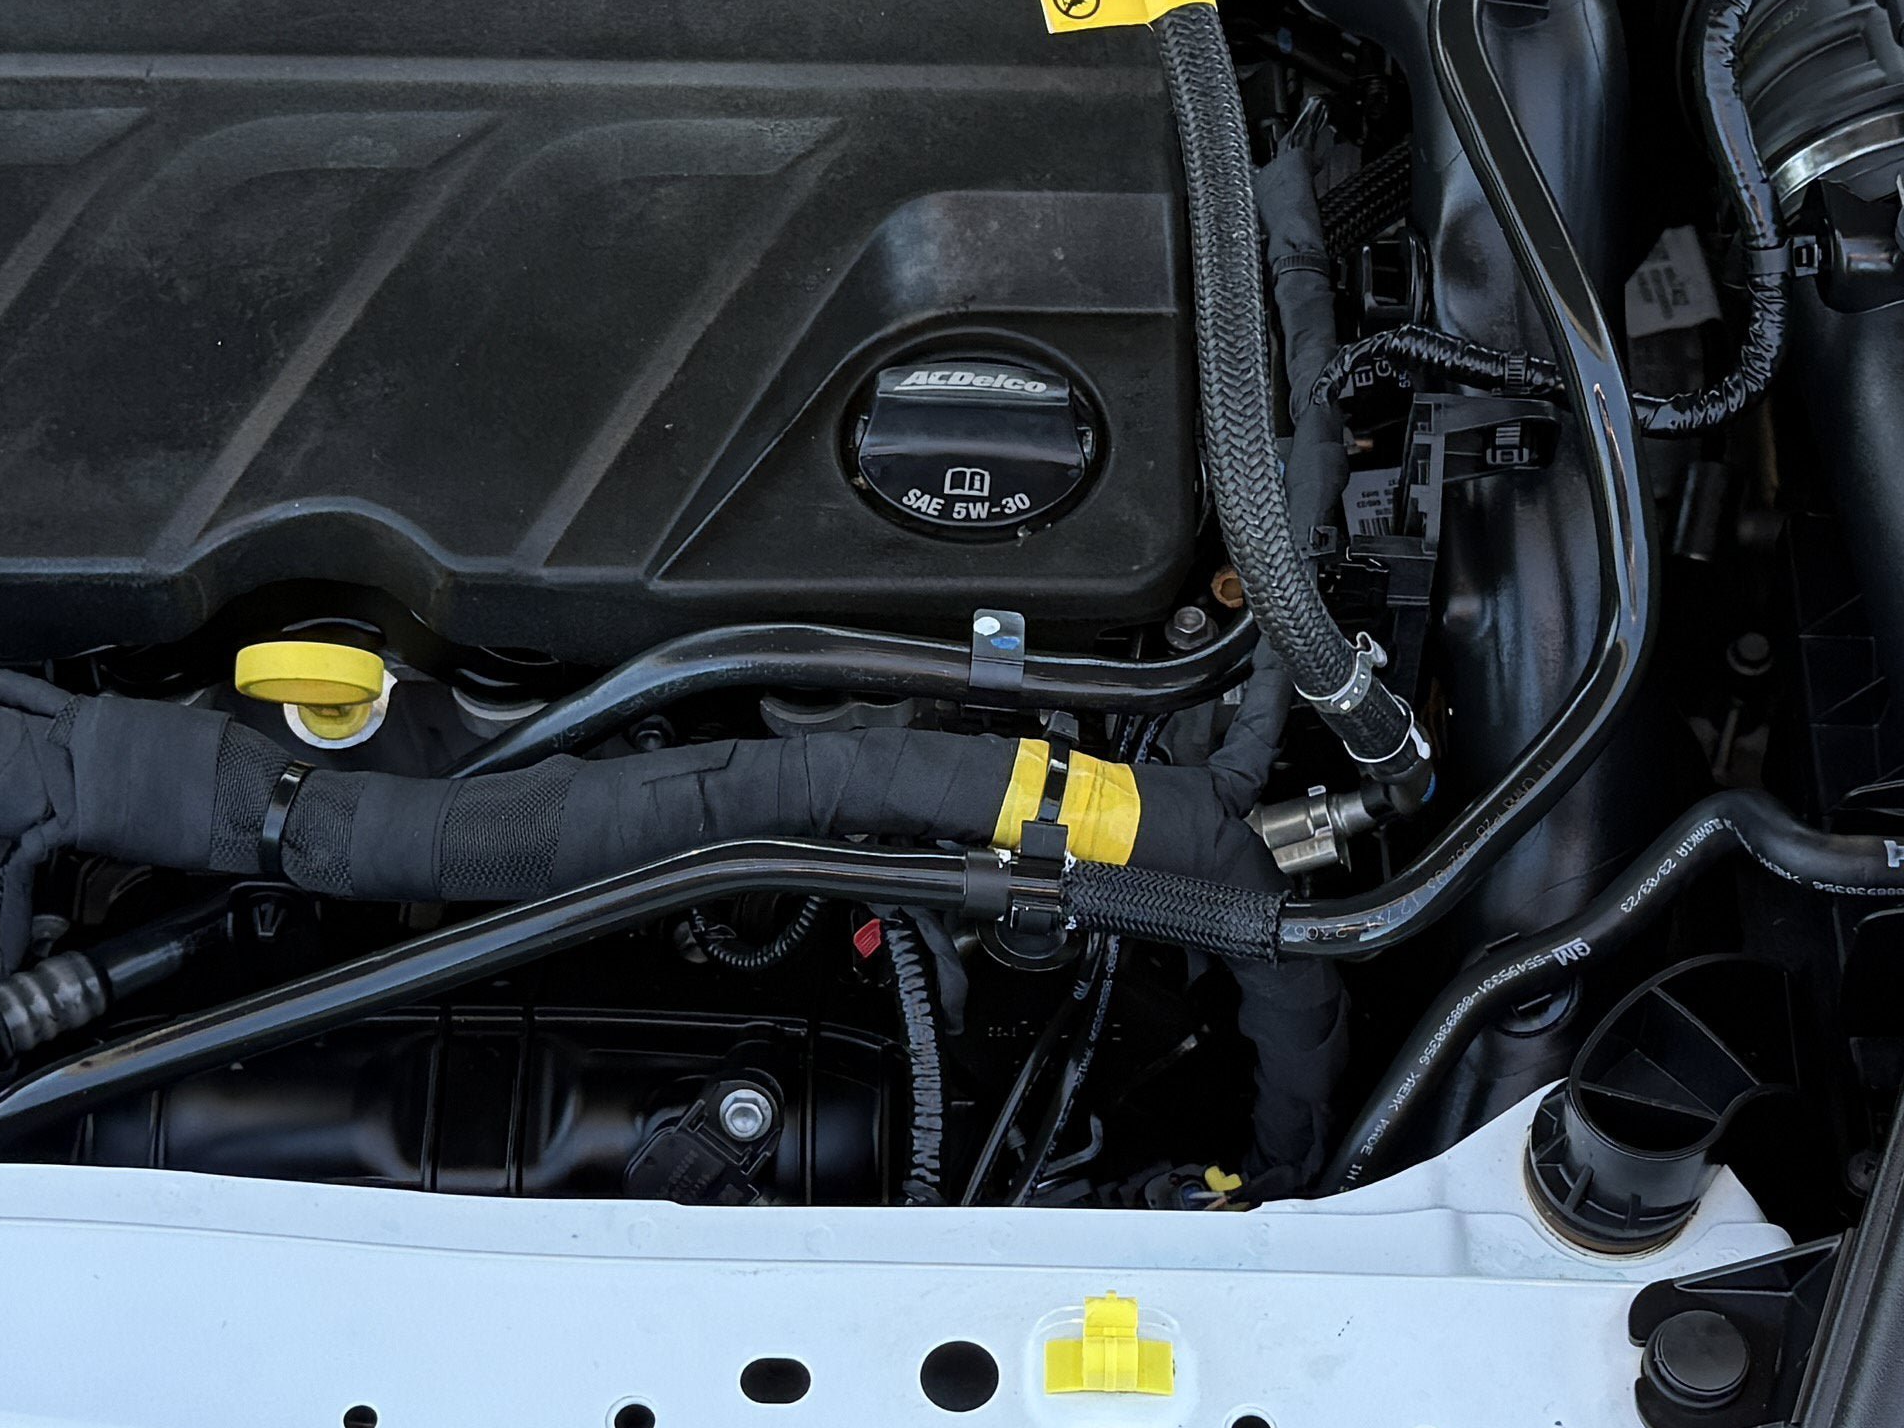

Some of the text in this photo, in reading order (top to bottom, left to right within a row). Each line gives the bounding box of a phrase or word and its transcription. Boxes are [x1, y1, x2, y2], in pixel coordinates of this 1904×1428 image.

[899, 370, 1047, 393] ACDelco
[902, 487, 1031, 520] SAE 5W-30
